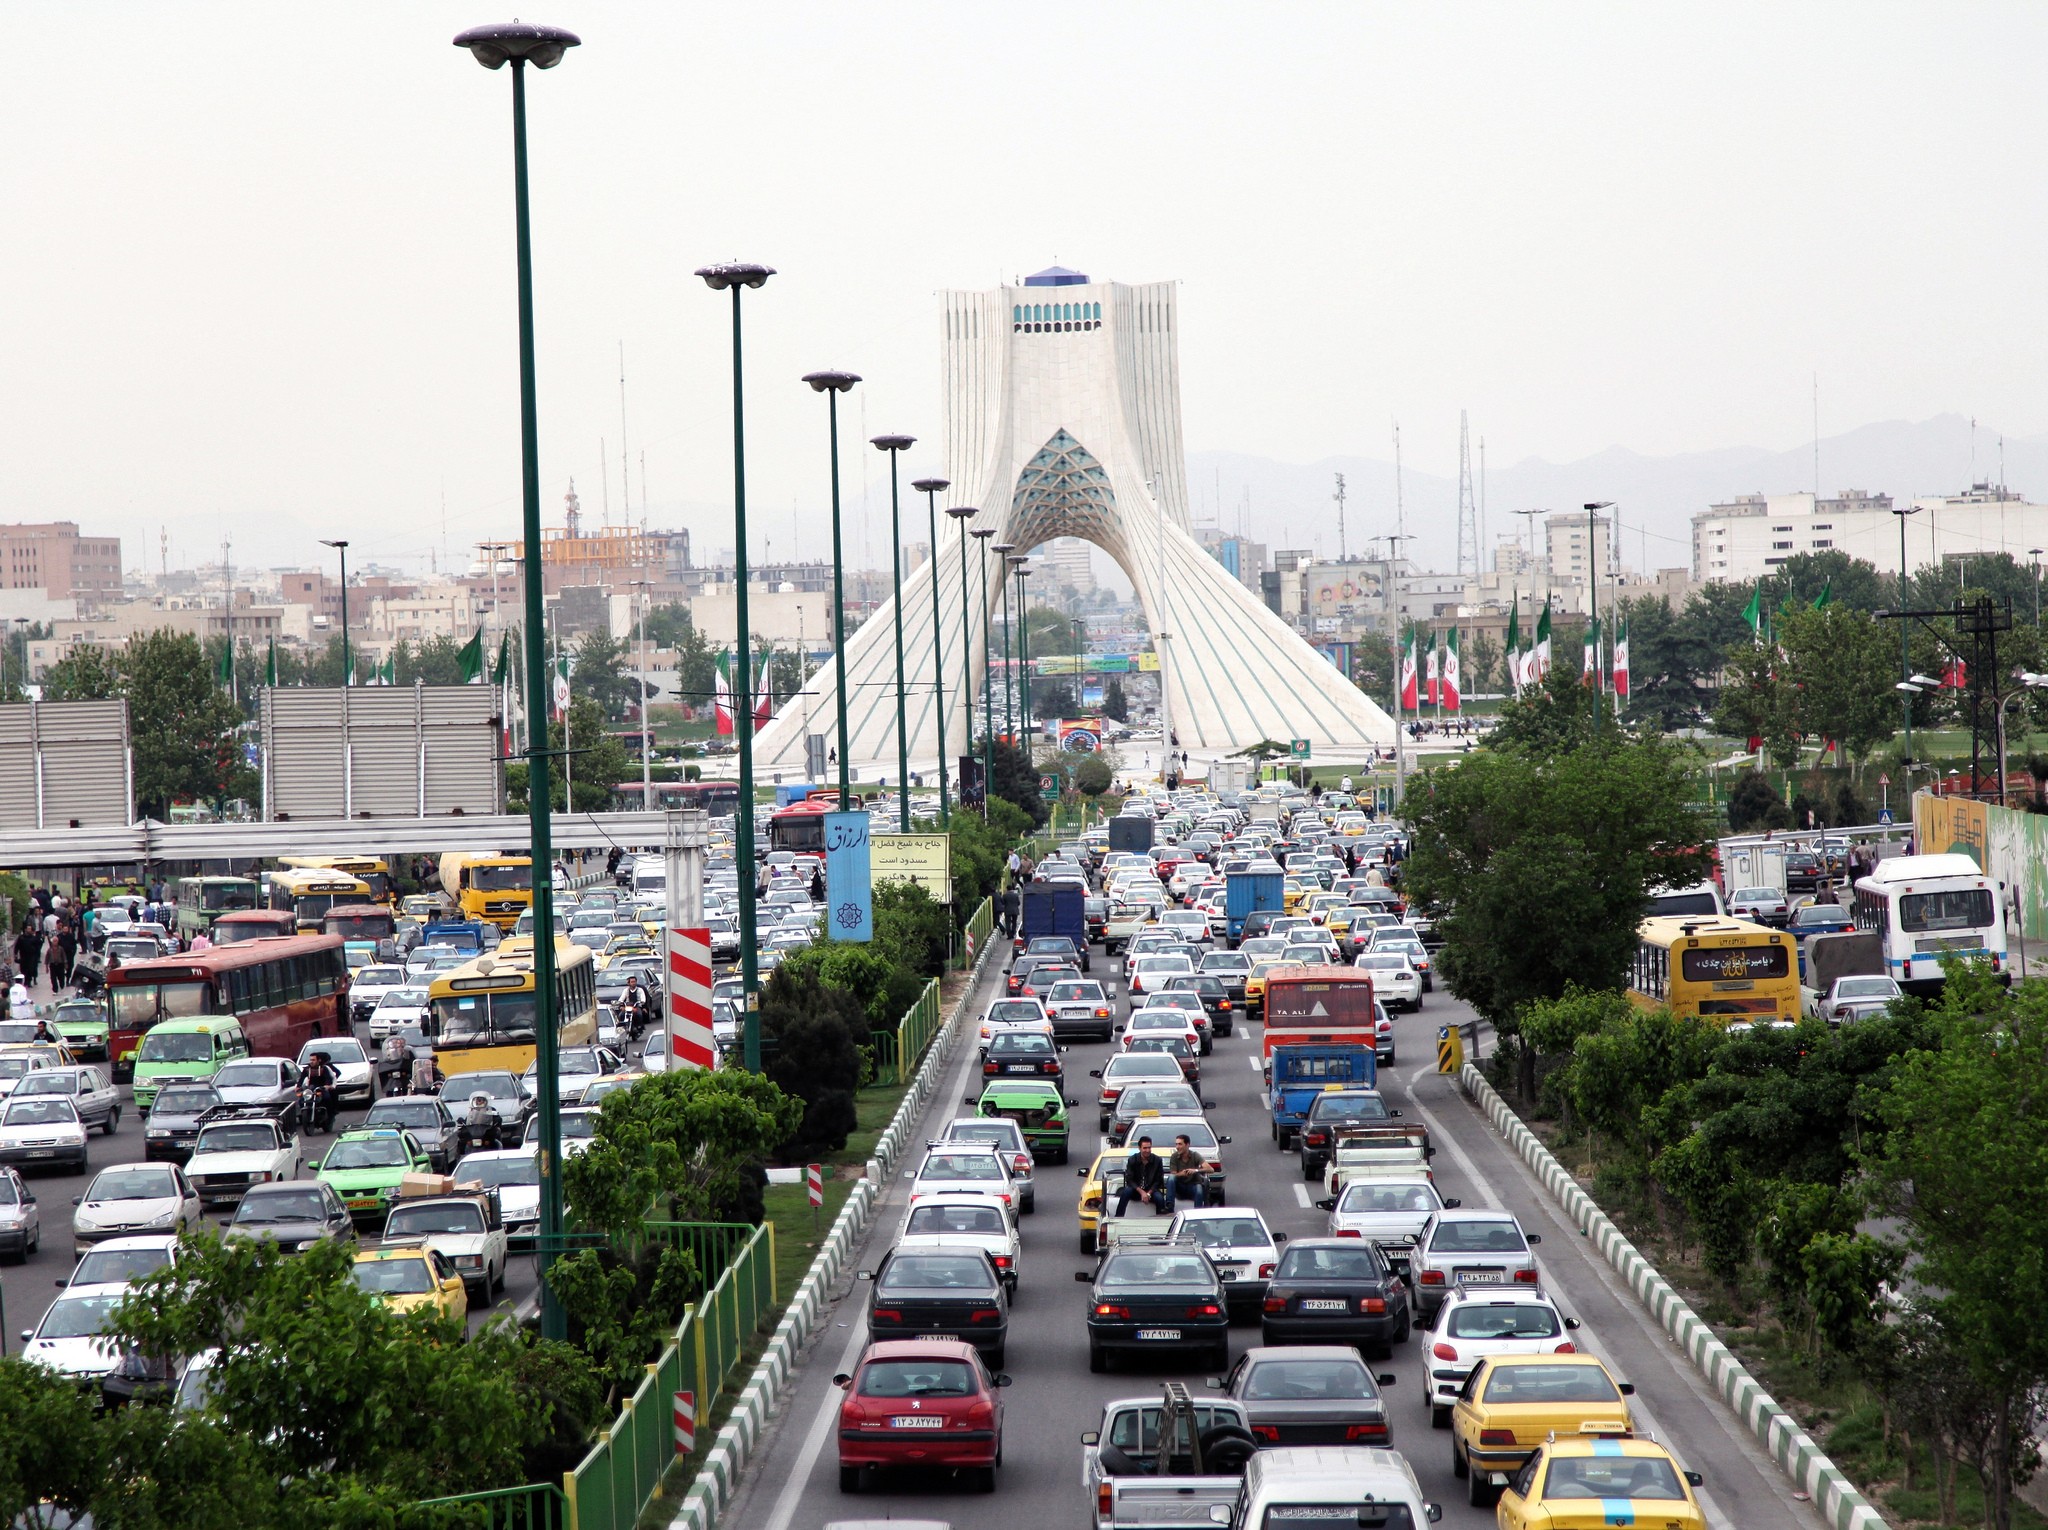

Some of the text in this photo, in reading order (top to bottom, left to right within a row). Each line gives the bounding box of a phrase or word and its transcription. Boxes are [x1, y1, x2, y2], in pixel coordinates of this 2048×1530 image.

[827, 825, 867, 852] الرزاق
[877, 840, 895, 849] فضل
[897, 840, 913, 850] شیخ
[915, 840, 923, 849] به
[924, 840, 941, 850] جناح
